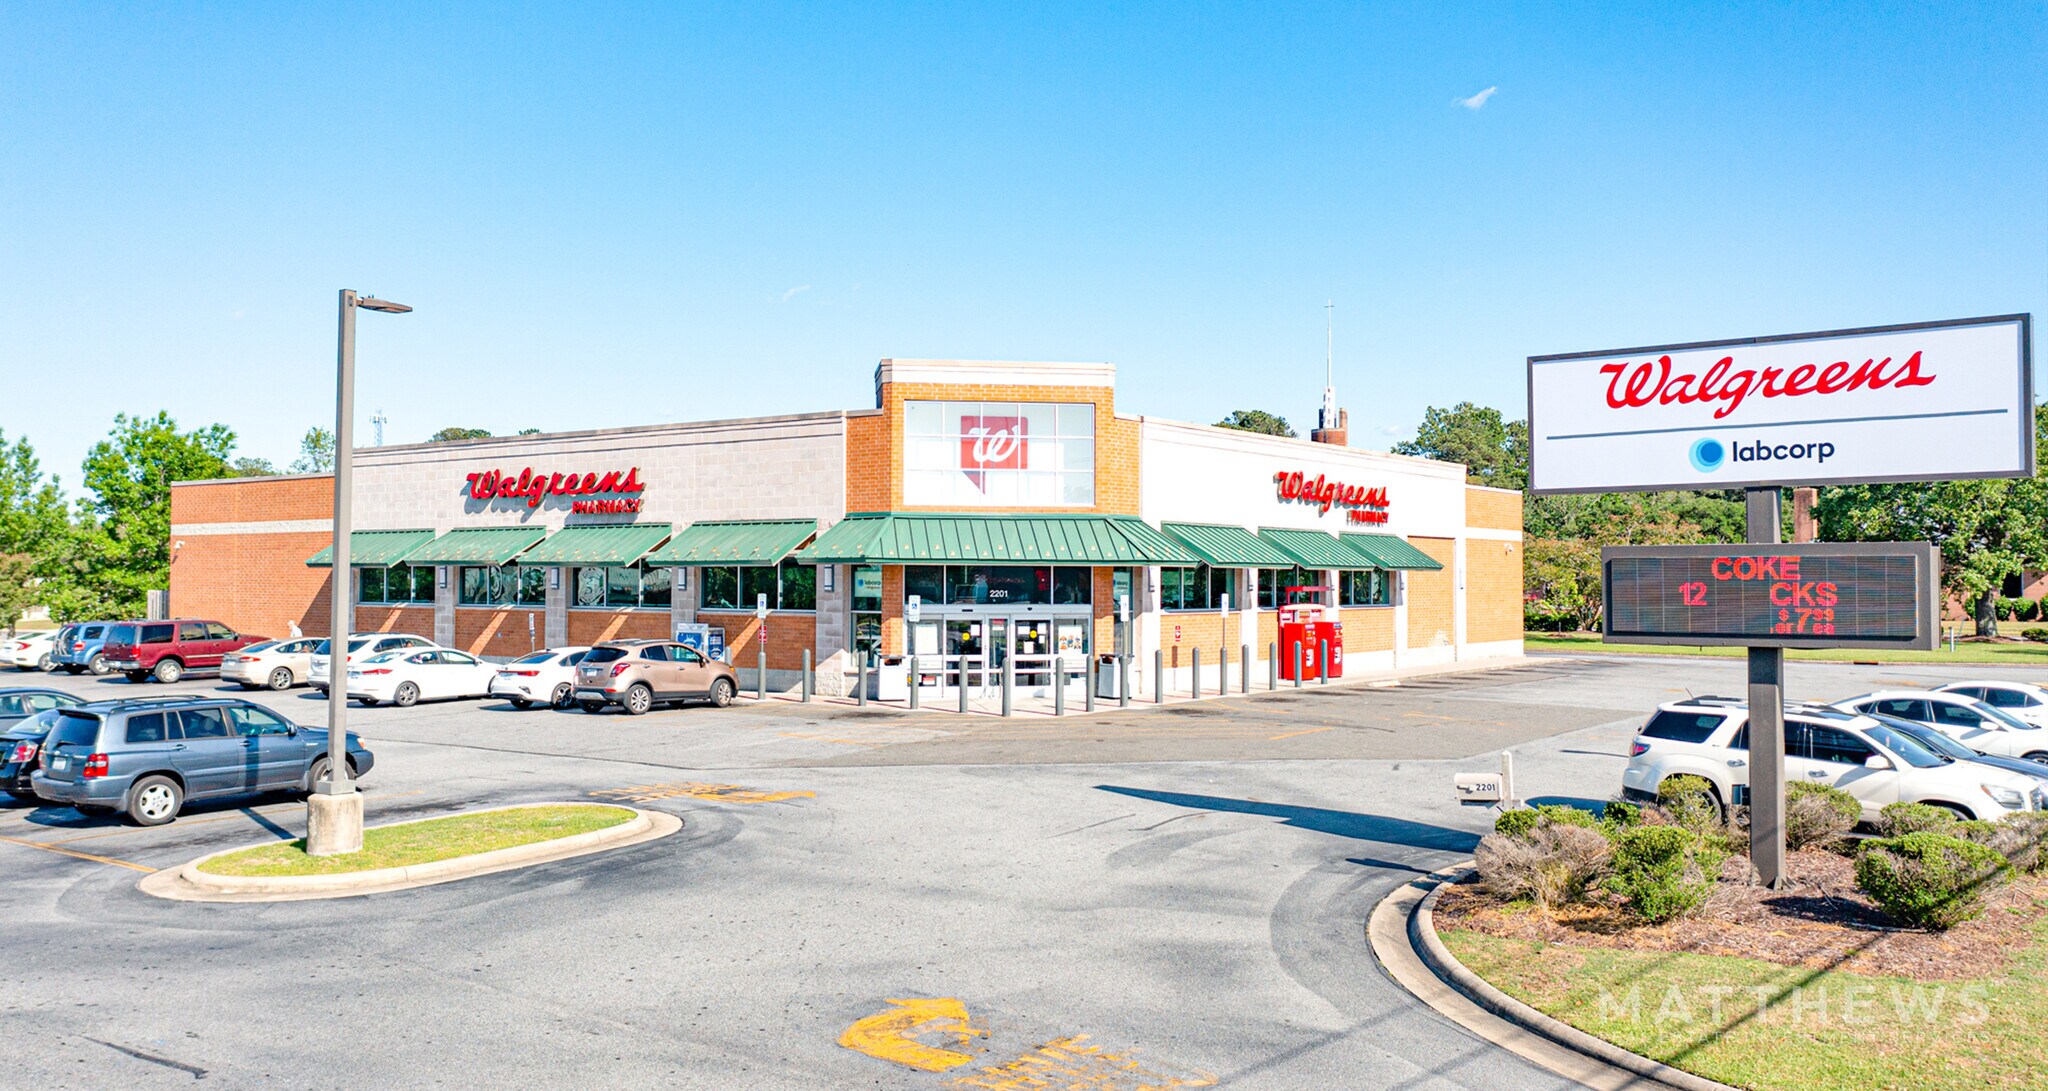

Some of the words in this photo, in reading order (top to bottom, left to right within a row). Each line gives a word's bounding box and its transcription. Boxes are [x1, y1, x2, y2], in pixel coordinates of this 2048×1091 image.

[1600, 351, 1936, 419] Walgreens
[1732, 439, 1834, 463] labcorp
[466, 467, 645, 508] Walgreens
[1275, 471, 1390, 513] Walgreens
[572, 498, 643, 515] PHARMACY
[1711, 556, 1801, 580] COKE
[989, 590, 1008, 598] 2201
[1679, 582, 1707, 606] 12
[1770, 582, 1838, 606] CKS
